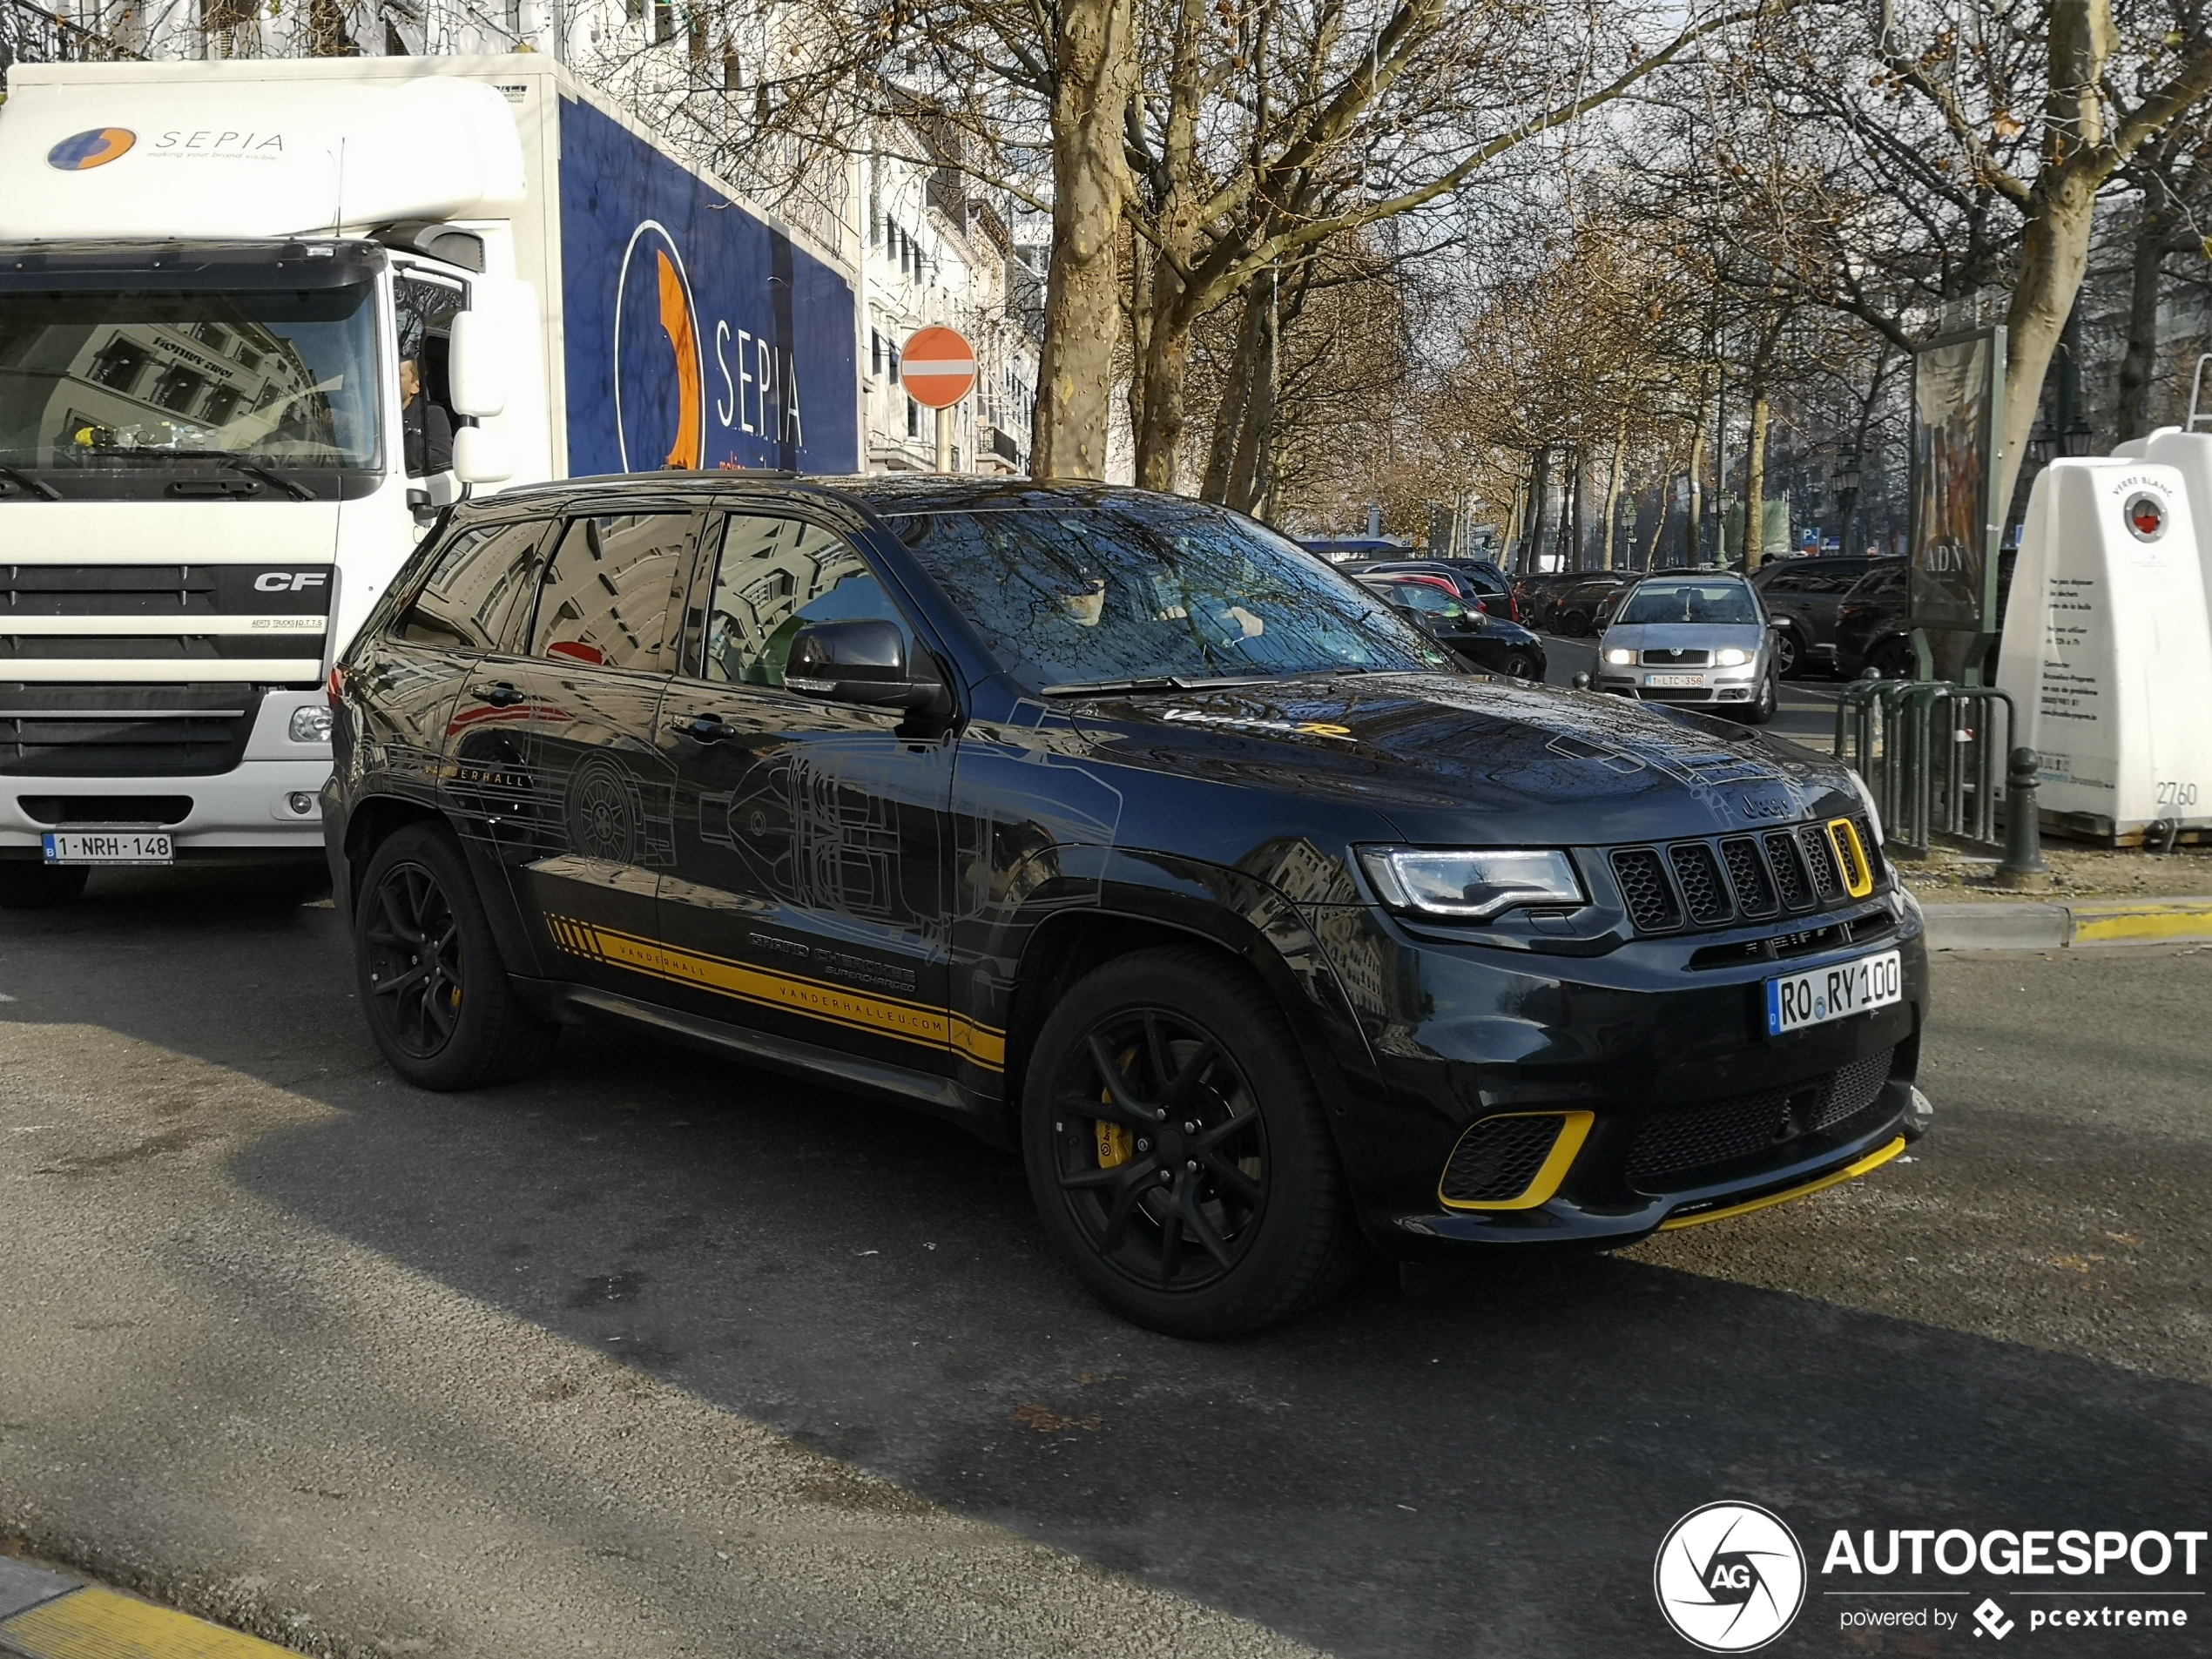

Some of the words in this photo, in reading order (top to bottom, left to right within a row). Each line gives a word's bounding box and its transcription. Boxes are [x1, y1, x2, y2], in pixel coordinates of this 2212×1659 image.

[155, 131, 283, 152] SEPIA
[717, 319, 803, 448] SEPIA
[2113, 476, 2139, 496] VERRE
[2141, 476, 2174, 498] BLANC
[1925, 545, 1964, 572] ADN
[254, 572, 327, 591] CF
[424, 764, 523, 786] VANDERHALL
[2156, 781, 2197, 806] 2760
[1743, 794, 1791, 820] Jeep
[46, 847, 55, 857] B
[619, 945, 705, 976] VANDERHALL
[749, 932, 810, 958] GRAND
[813, 948, 917, 984] CHEROKEE
[824, 966, 917, 993] SUPERCHARGED
[779, 985, 943, 1033] VANDERHALLEU.COM
[1770, 1013, 1777, 1026] D
[1781, 978, 1811, 1026] RO
